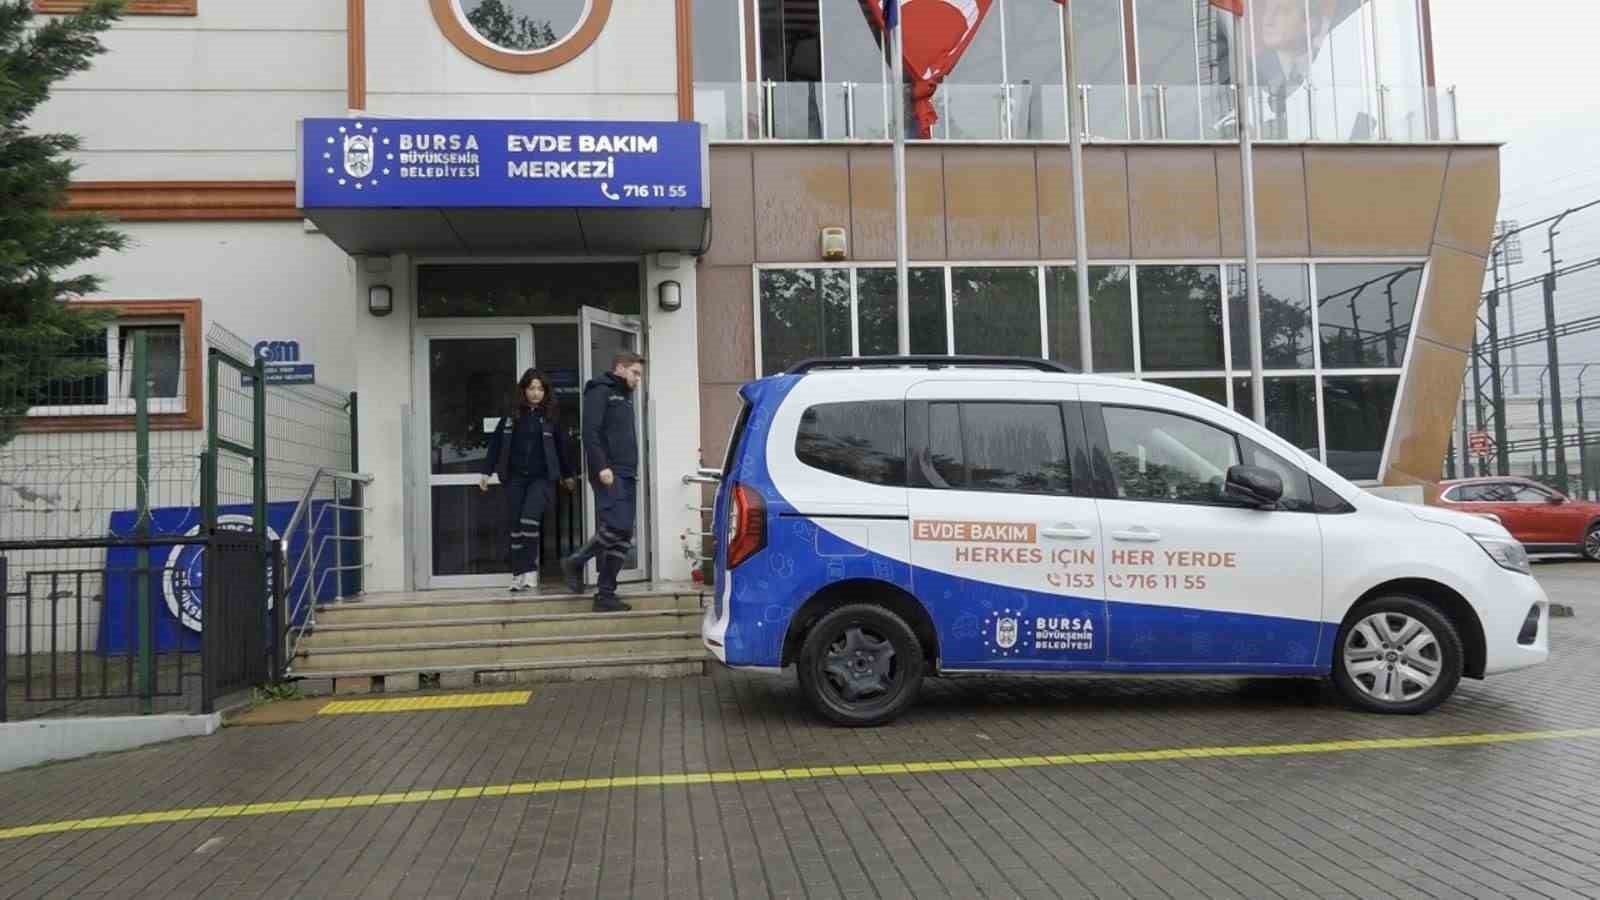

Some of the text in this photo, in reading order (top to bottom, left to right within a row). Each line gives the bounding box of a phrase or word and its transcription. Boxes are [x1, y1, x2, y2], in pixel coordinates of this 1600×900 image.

[399, 134, 479, 150] BURSA
[507, 134, 658, 153] EVDE BAKIM
[399, 151, 480, 165] BÜYÜKŞEHİR
[400, 165, 480, 178] BELEDİYESİ
[507, 157, 614, 178] MERKEZİ
[623, 184, 687, 198] 716 11 55
[917, 523, 1028, 541] EVDE BAKIM
[955, 546, 1043, 564] HERKES
[1111, 550, 1154, 566] HER
[1165, 551, 1237, 568] YERDE
[1065, 573, 1095, 588] 153
[1126, 574, 1206, 590] 716 11 55
[1036, 617, 1093, 630] BURSA
